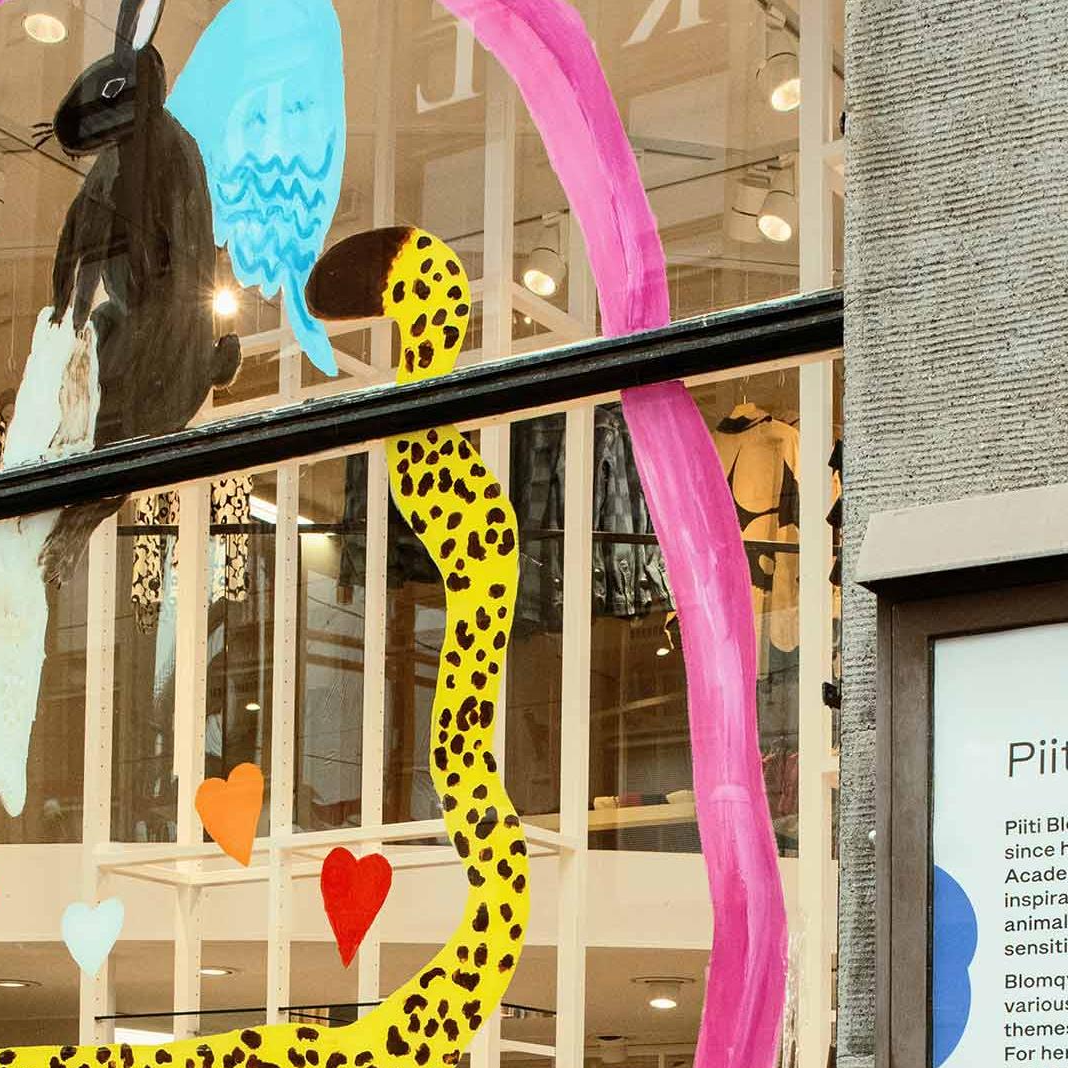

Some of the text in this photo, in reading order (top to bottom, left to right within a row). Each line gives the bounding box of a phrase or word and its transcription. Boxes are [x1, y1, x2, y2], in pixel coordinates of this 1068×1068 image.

[1005, 816, 1068, 836] Piiti Bl
[1004, 843, 1055, 860] since
[1004, 866, 1068, 884] Acade
[1004, 890, 1068, 910] inspira
[1004, 914, 1068, 932] animal
[1004, 938, 1068, 956] sensiti
[1005, 973, 1068, 990] Blomq
[1004, 1022, 1068, 1037] theme
[1004, 1046, 1036, 1061] For
